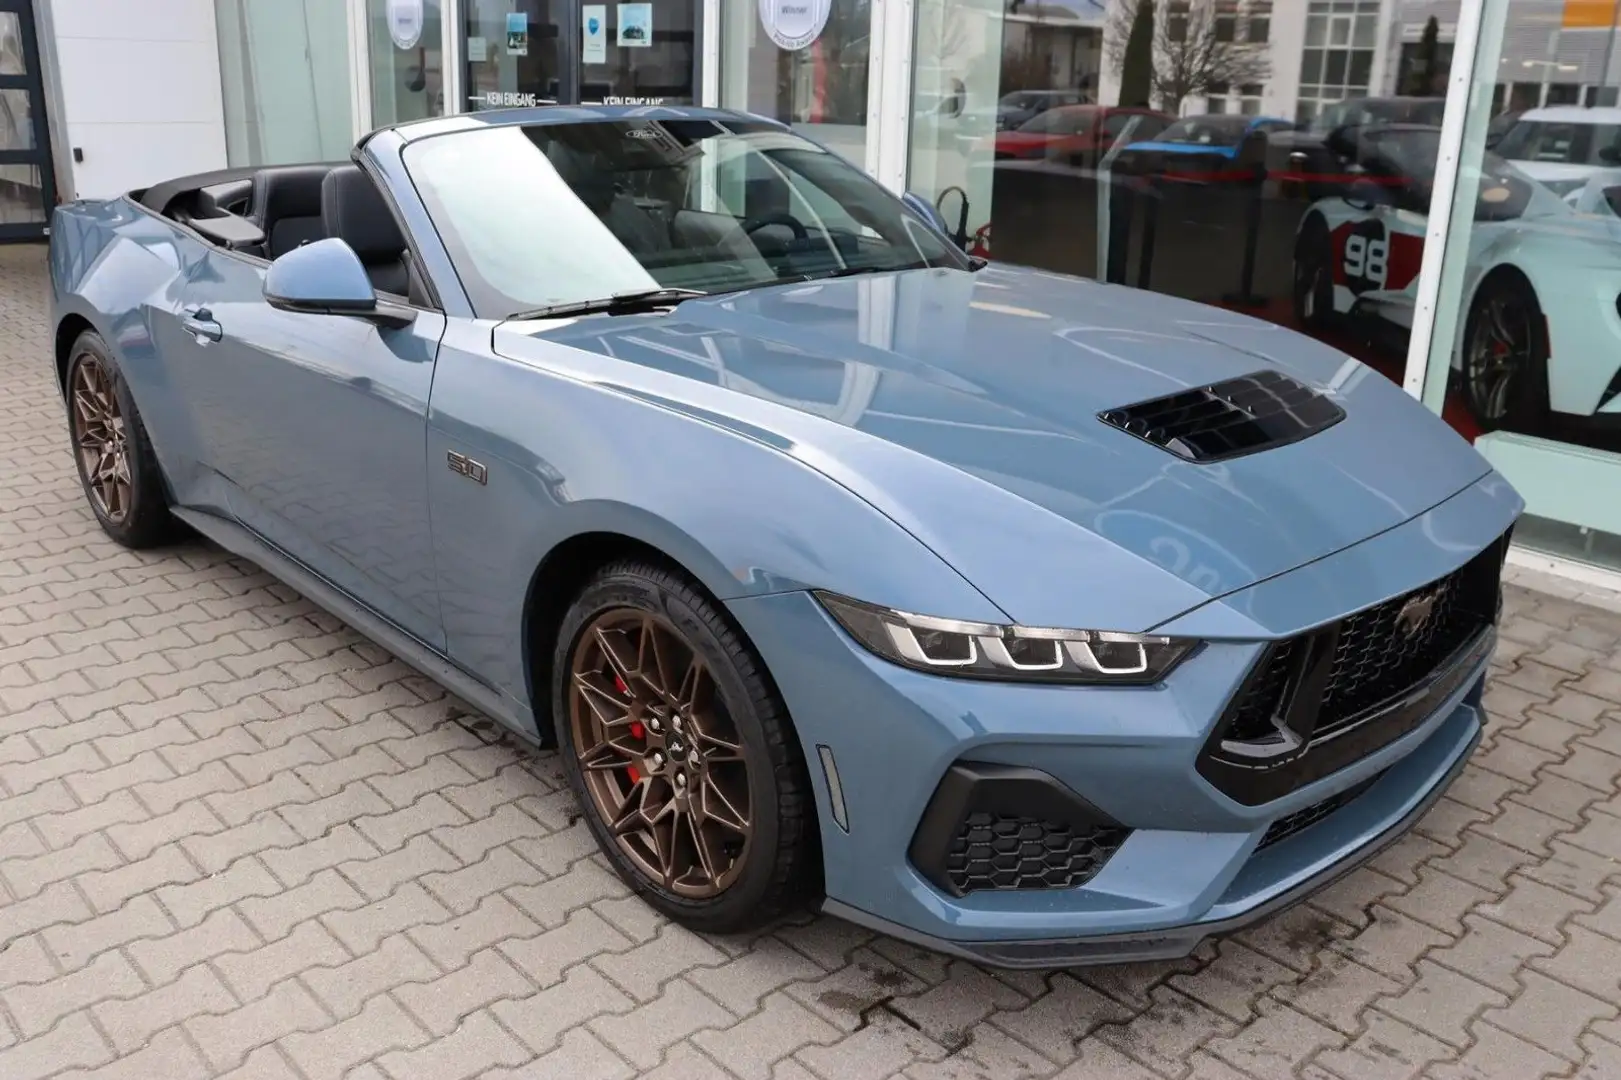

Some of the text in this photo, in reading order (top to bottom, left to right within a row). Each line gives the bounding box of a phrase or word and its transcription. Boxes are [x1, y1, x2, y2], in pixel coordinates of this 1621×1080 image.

[486, 92, 536, 107] KEIN EINGANG
[1344, 234, 1387, 282] 98
